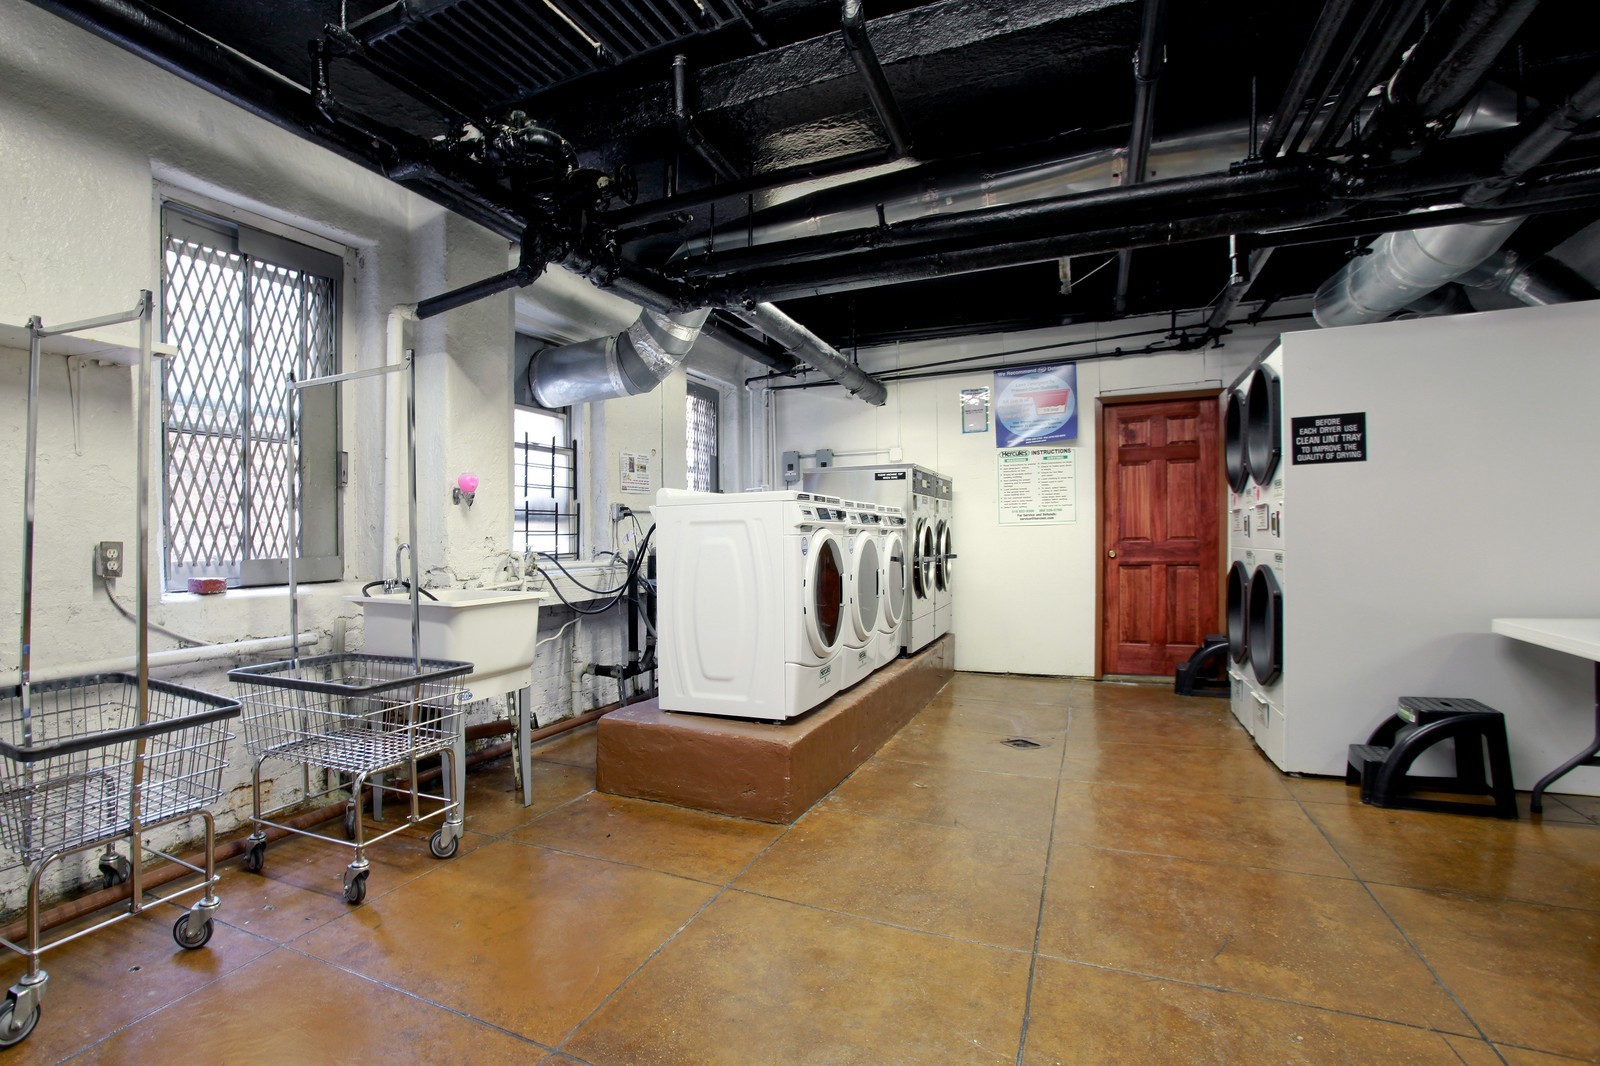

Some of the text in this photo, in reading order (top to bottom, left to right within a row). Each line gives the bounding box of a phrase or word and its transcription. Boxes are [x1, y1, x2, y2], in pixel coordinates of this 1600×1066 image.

[1315, 418, 1341, 427] BEFORE
[1319, 426, 1342, 434] DRYER
[1344, 424, 1358, 432] USE
[1295, 433, 1362, 445] CLEAN LINT TRAY
[1031, 448, 1071, 456] INSTRUCTIONS
[1312, 444, 1342, 453] IMPROVE
[1344, 443, 1358, 451] THE
[1297, 450, 1362, 462] QUALITY OF DRYING
